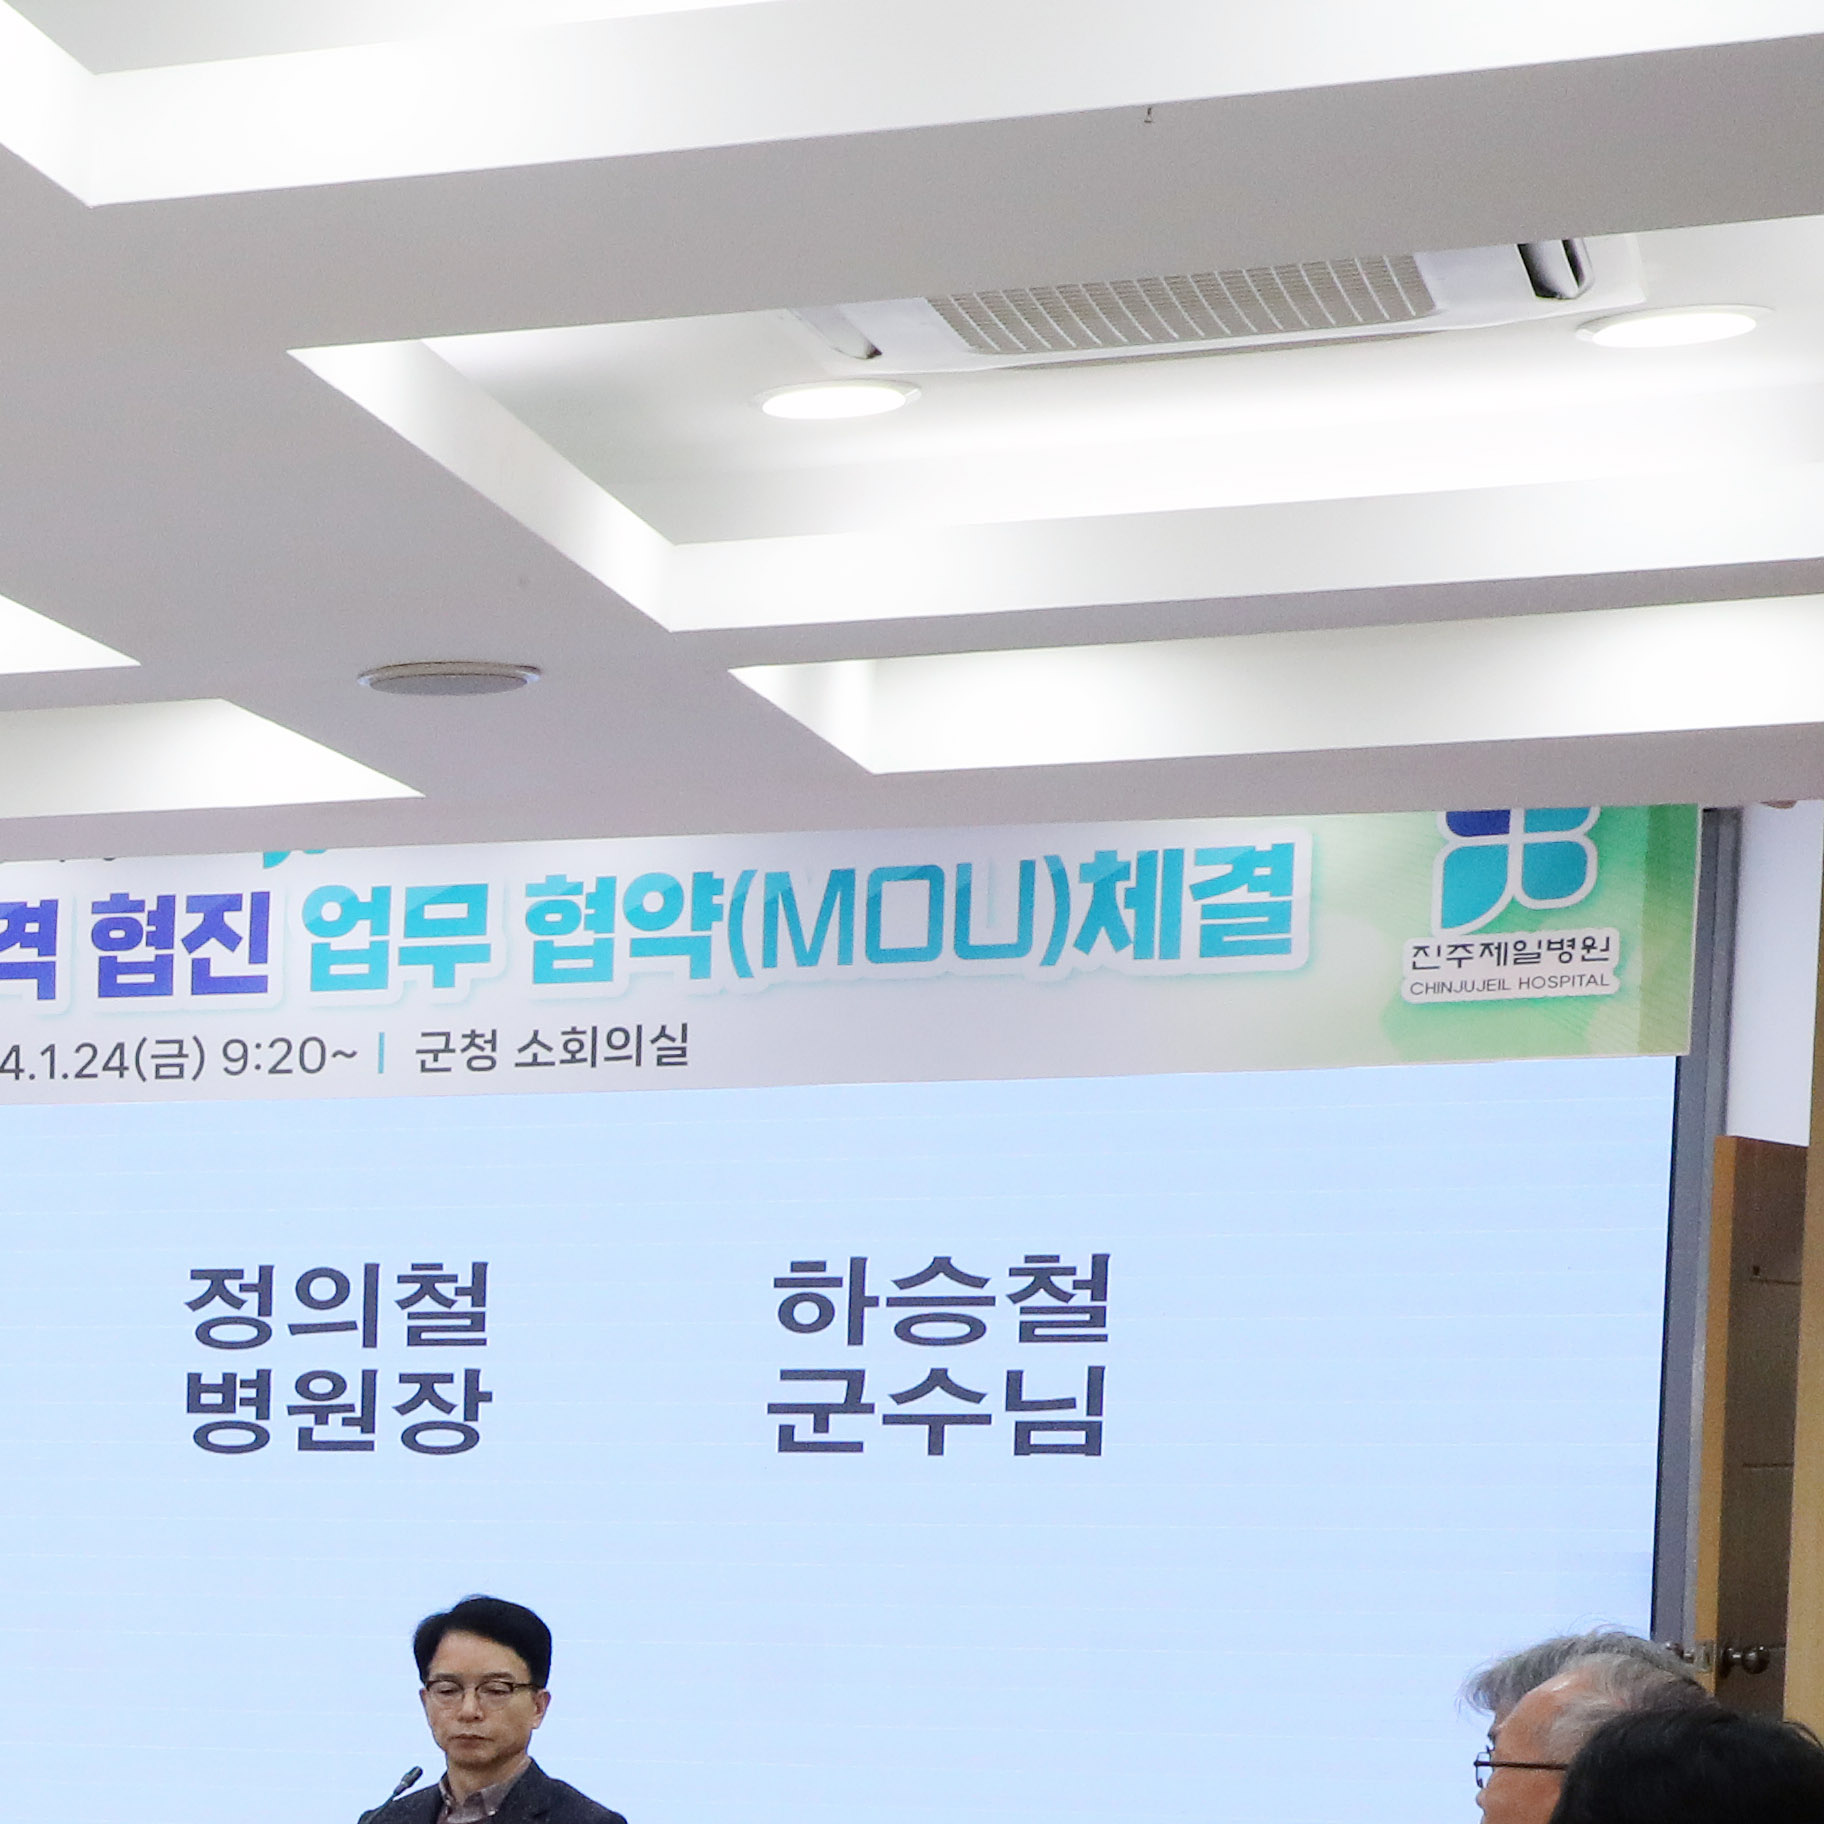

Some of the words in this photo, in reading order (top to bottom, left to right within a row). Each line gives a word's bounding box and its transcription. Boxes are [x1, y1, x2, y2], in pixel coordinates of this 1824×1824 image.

[90, 890, 272, 999] 협진
[301, 882, 492, 992] 업무
[524, 841, 1297, 985] 협약(MOU)체결
[1411, 935, 1611, 971] 진주제일병원
[1409, 979, 1512, 996] CHINJUJEIL
[1518, 973, 1611, 991] HOSPITAL
[222, 1036, 357, 1076] 9:20~
[416, 1029, 500, 1073] 군청
[514, 1022, 690, 1069] 소회의실
[185, 1261, 489, 1350] 정의철
[773, 1253, 1111, 1347] 하승철
[186, 1366, 493, 1456] 병원장
[766, 1363, 1107, 1457] 군수님
